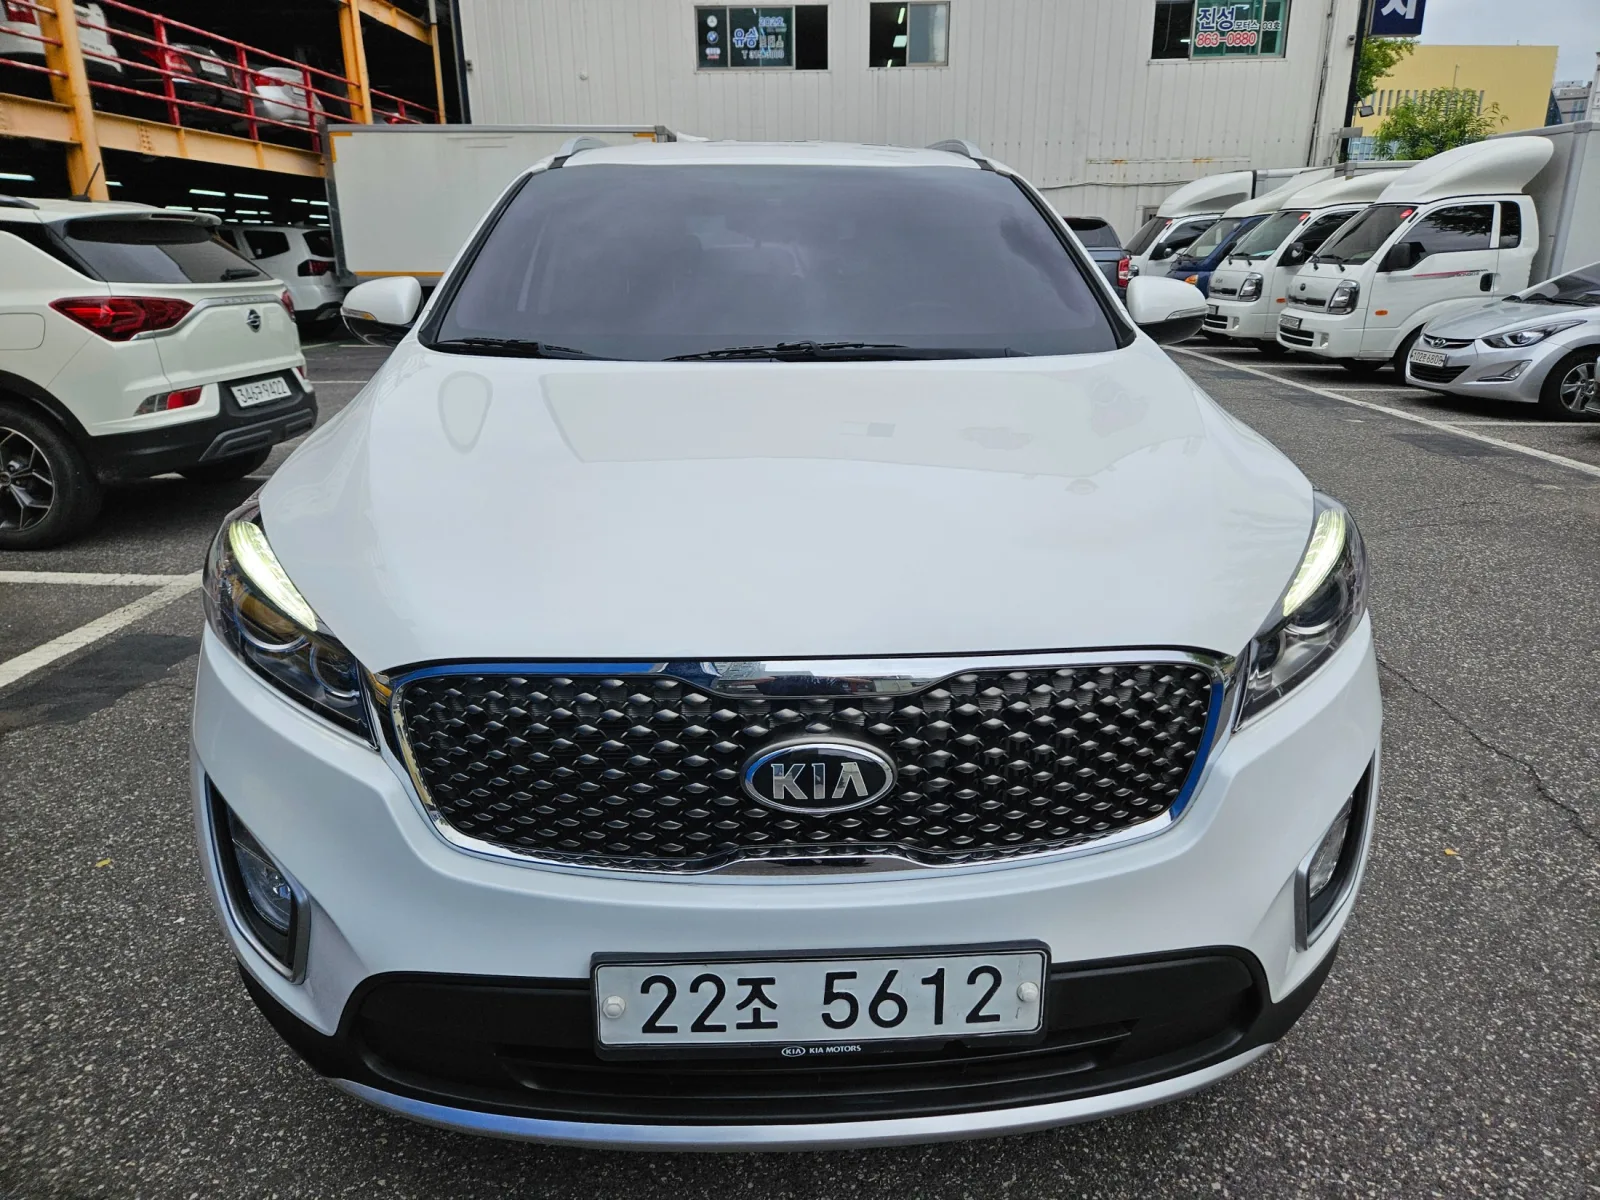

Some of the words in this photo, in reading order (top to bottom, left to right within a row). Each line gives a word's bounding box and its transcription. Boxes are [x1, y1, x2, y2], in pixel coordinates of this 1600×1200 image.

[1197, 6, 1236, 31] 진성
[1234, 20, 1260, 31] 모터스
[1196, 31, 1257, 47] 863-0880
[770, 761, 869, 800] KIA
[640, 973, 778, 1034] 22조
[821, 965, 1003, 1030] 5612
[785, 1047, 802, 1055] KIA
[825, 1045, 861, 1053] MOTORS
